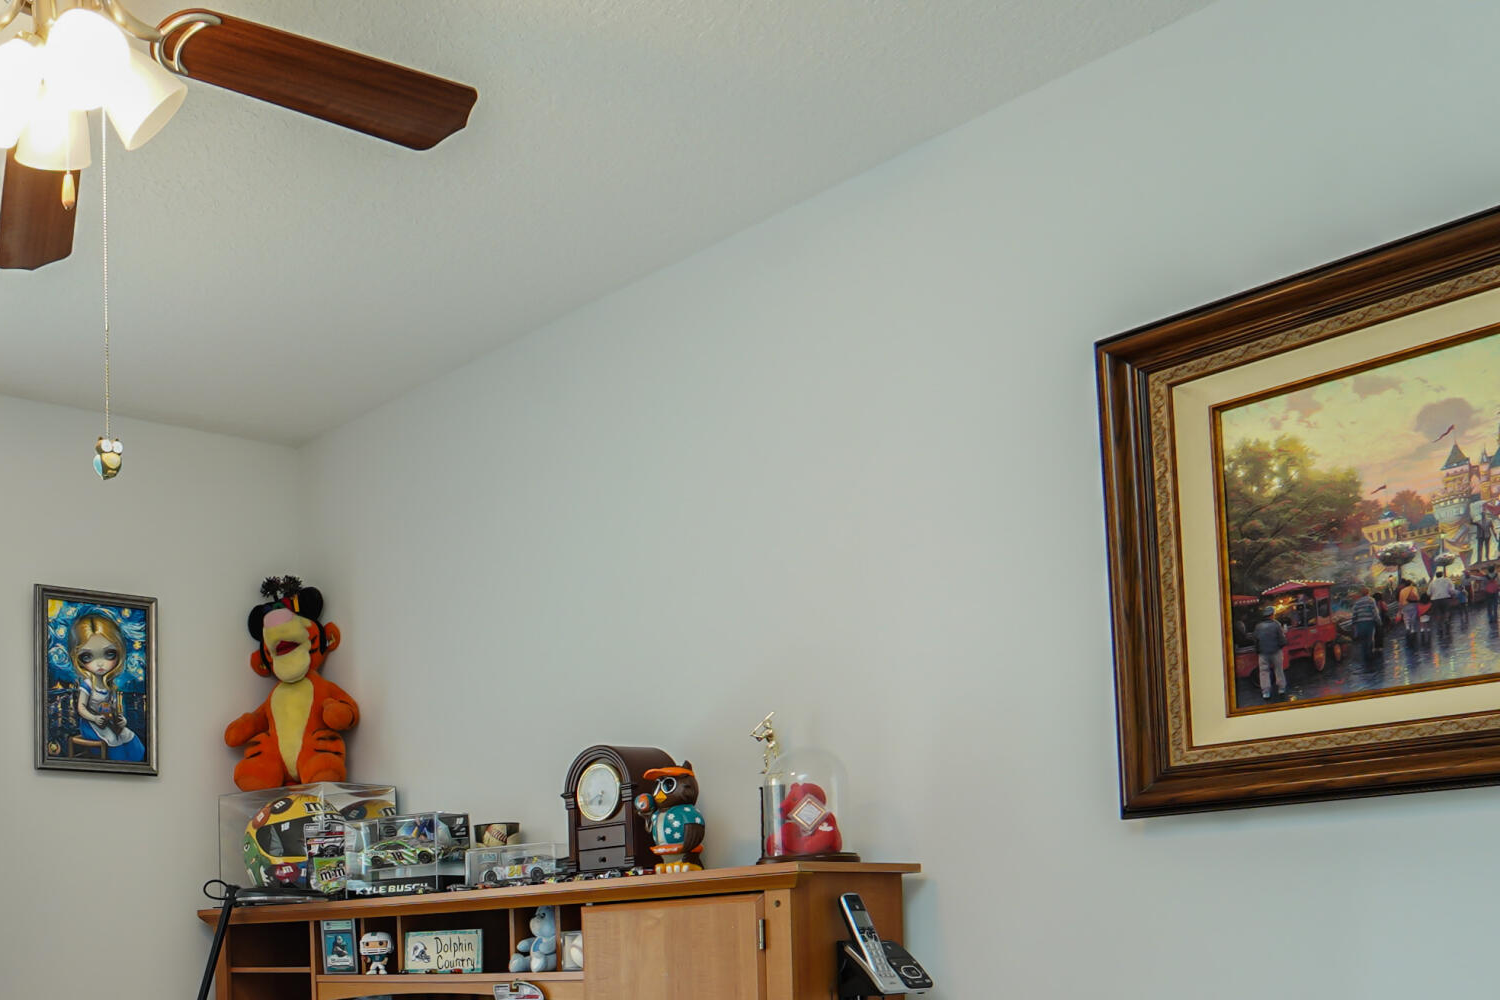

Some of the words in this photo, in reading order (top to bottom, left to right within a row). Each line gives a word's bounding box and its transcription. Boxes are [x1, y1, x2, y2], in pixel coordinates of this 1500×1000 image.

[507, 865, 522, 877] 24
[355, 885, 387, 895] KYLE
[434, 935, 474, 957] Dolphin
[436, 956, 475, 971] Country
